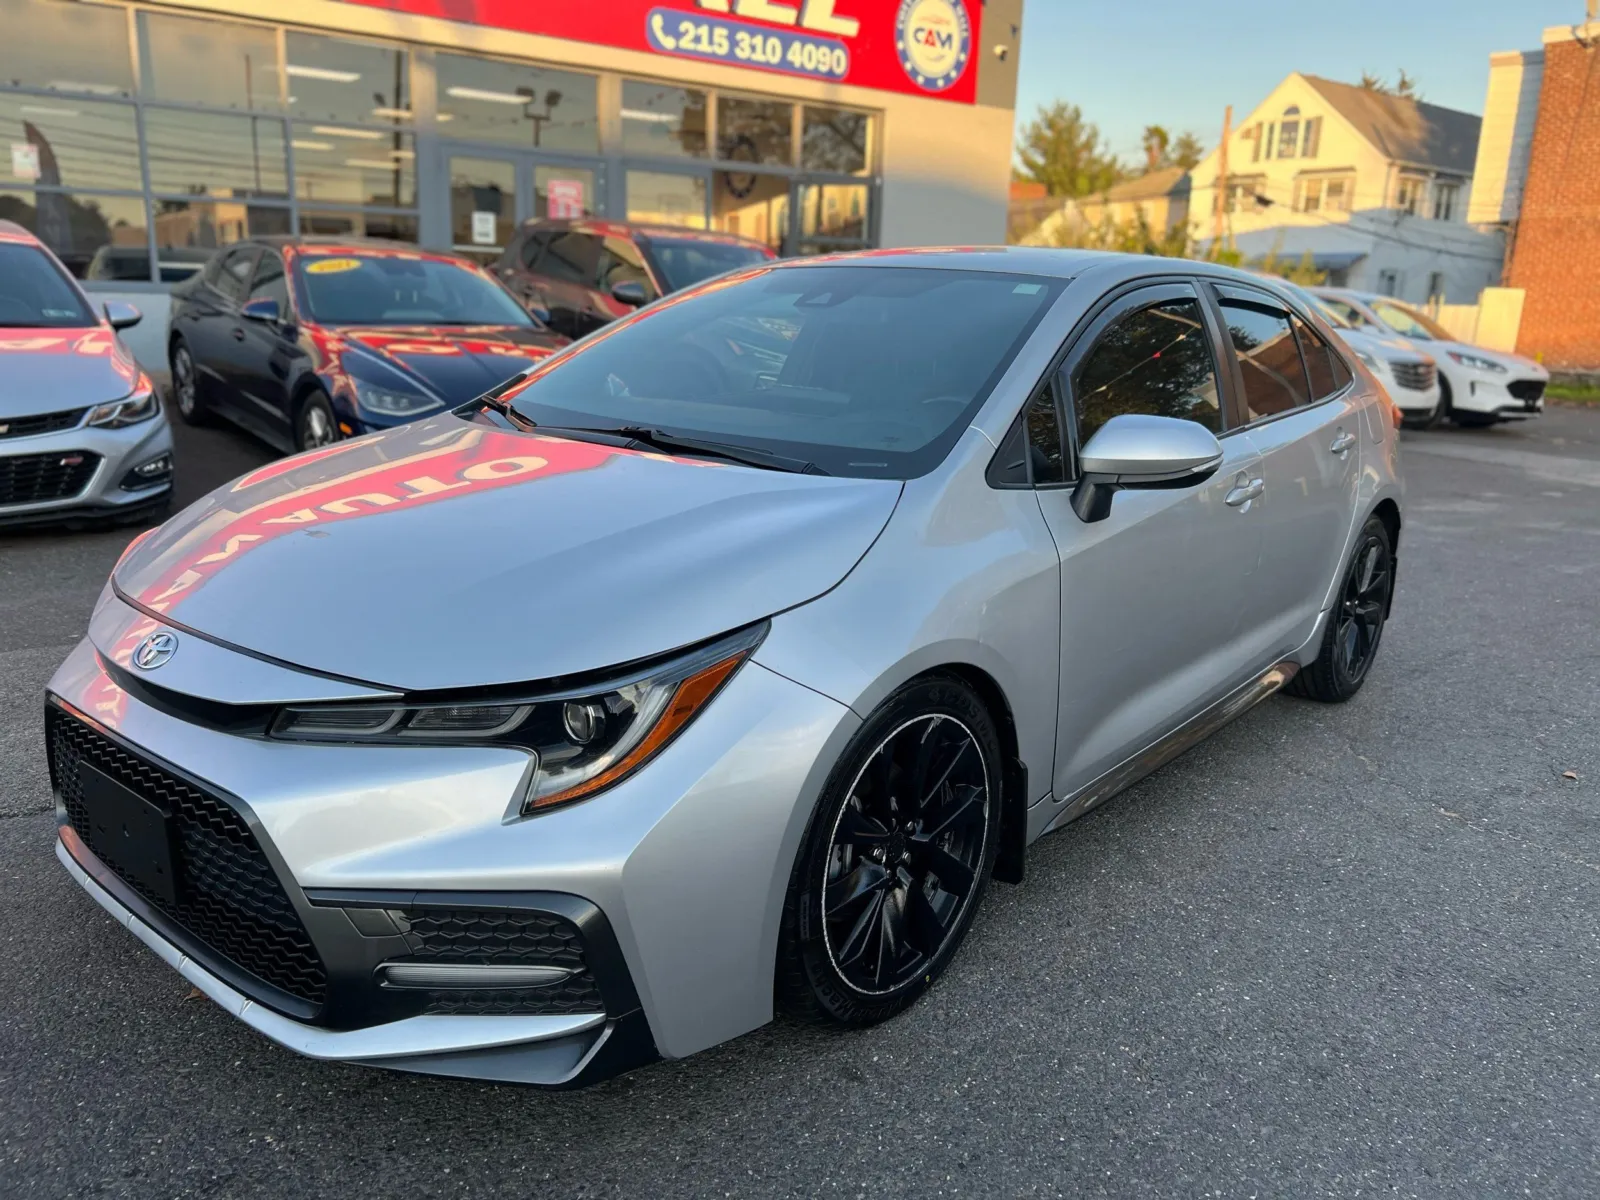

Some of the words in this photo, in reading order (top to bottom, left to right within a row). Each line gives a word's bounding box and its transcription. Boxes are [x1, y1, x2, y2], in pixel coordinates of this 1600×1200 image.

[678, 21, 729, 56] 215
[735, 31, 782, 64] 310
[786, 41, 847, 75] 4090
[913, 27, 953, 50] CAM
